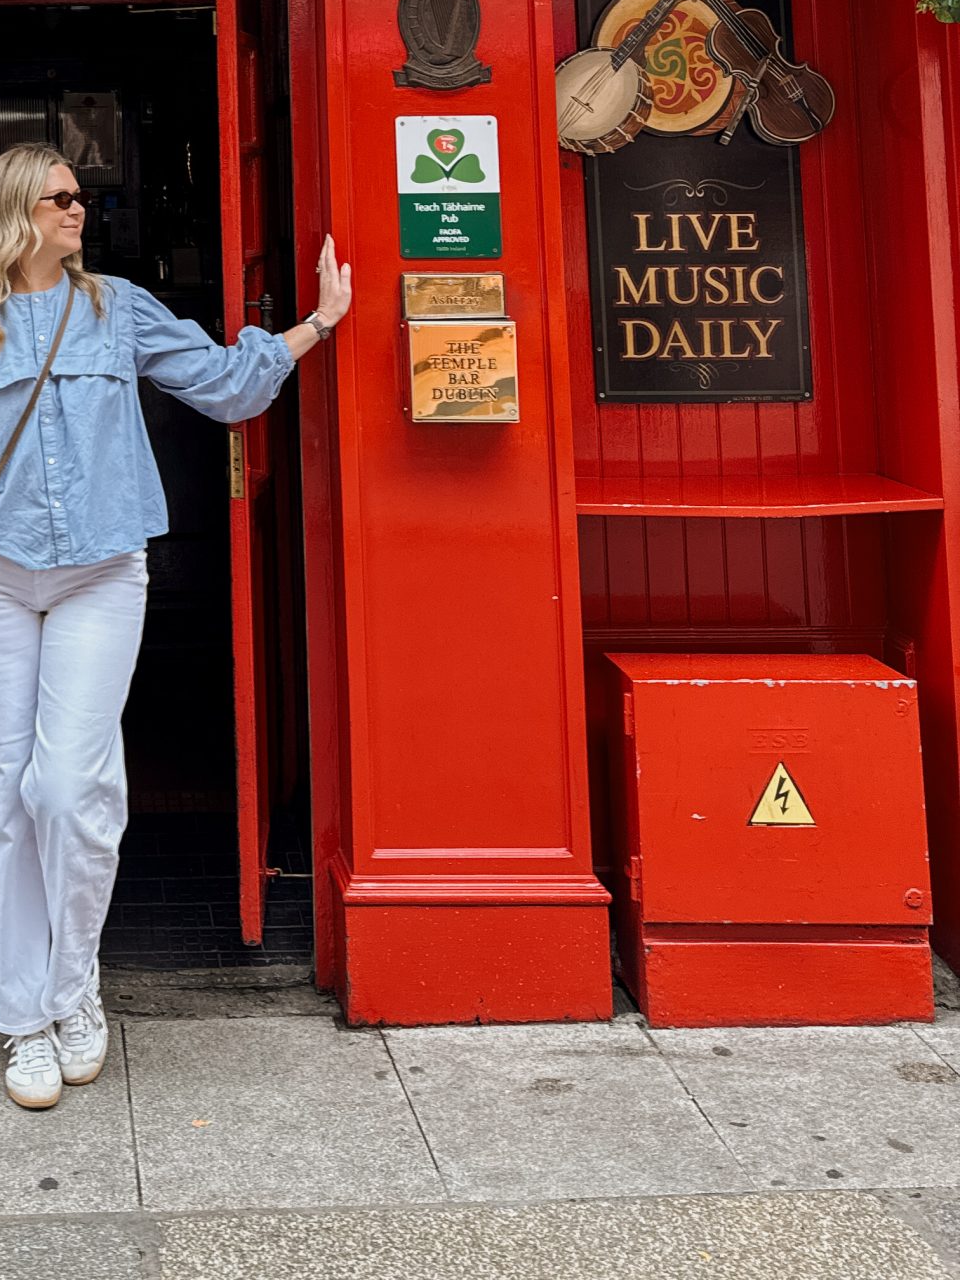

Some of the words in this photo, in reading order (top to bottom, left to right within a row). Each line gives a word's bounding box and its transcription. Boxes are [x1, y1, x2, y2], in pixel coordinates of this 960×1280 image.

[413, 202, 440, 212] Teach
[441, 214, 459, 223] Pub
[632, 212, 761, 252] LIVE
[613, 265, 785, 305] MUSIC
[429, 295, 483, 307] Ashtray
[620, 319, 783, 360] DAILY
[447, 342, 481, 354] THE
[431, 358, 498, 370] TEMPLE
[448, 373, 481, 385] BAR
[432, 388, 498, 400] DUBLIN
